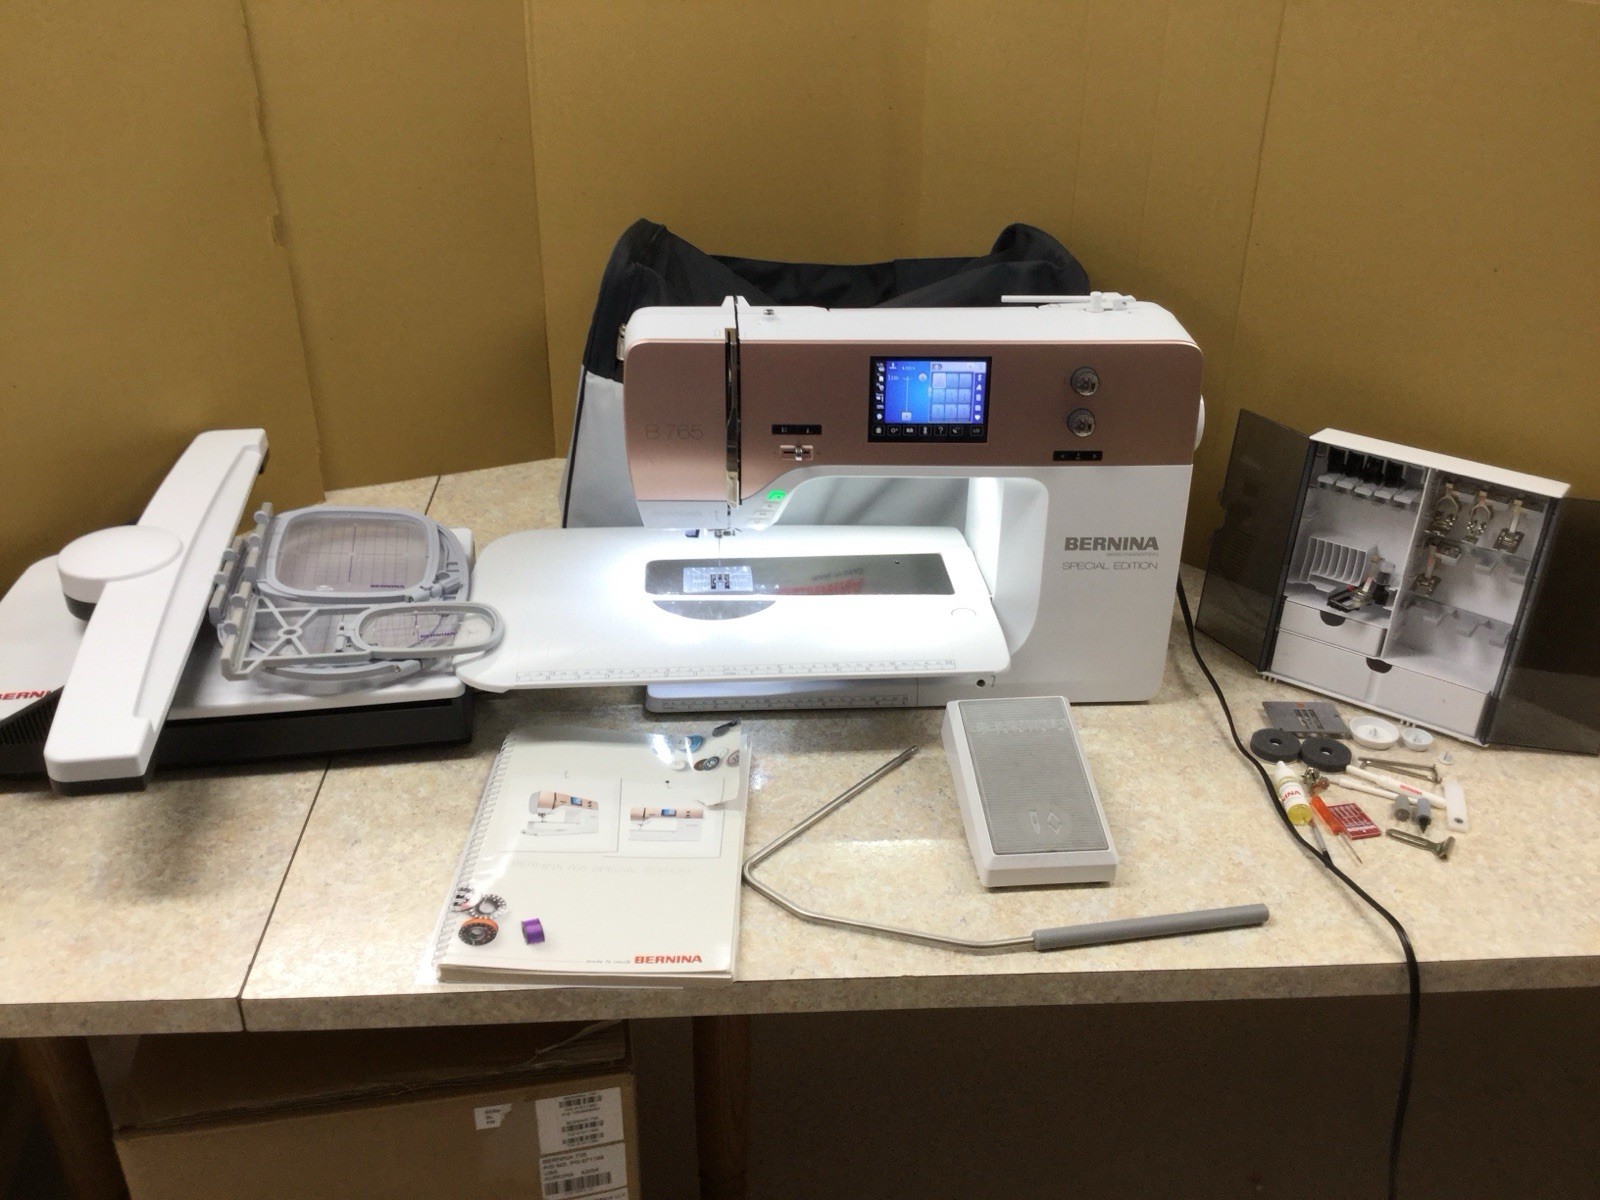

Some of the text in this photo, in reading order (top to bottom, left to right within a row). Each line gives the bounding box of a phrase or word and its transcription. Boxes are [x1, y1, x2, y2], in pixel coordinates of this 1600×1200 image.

[645, 423, 704, 441] B 765
[1065, 537, 1159, 551] BERNINA
[1062, 561, 1159, 571] SPECIAL EDITION
[420, 631, 456, 639] BERNINA
[971, 718, 1069, 734] BERNINA
[511, 859, 564, 872] BERNINA
[643, 866, 691, 875] EDITION
[634, 954, 703, 965] BERNINA
